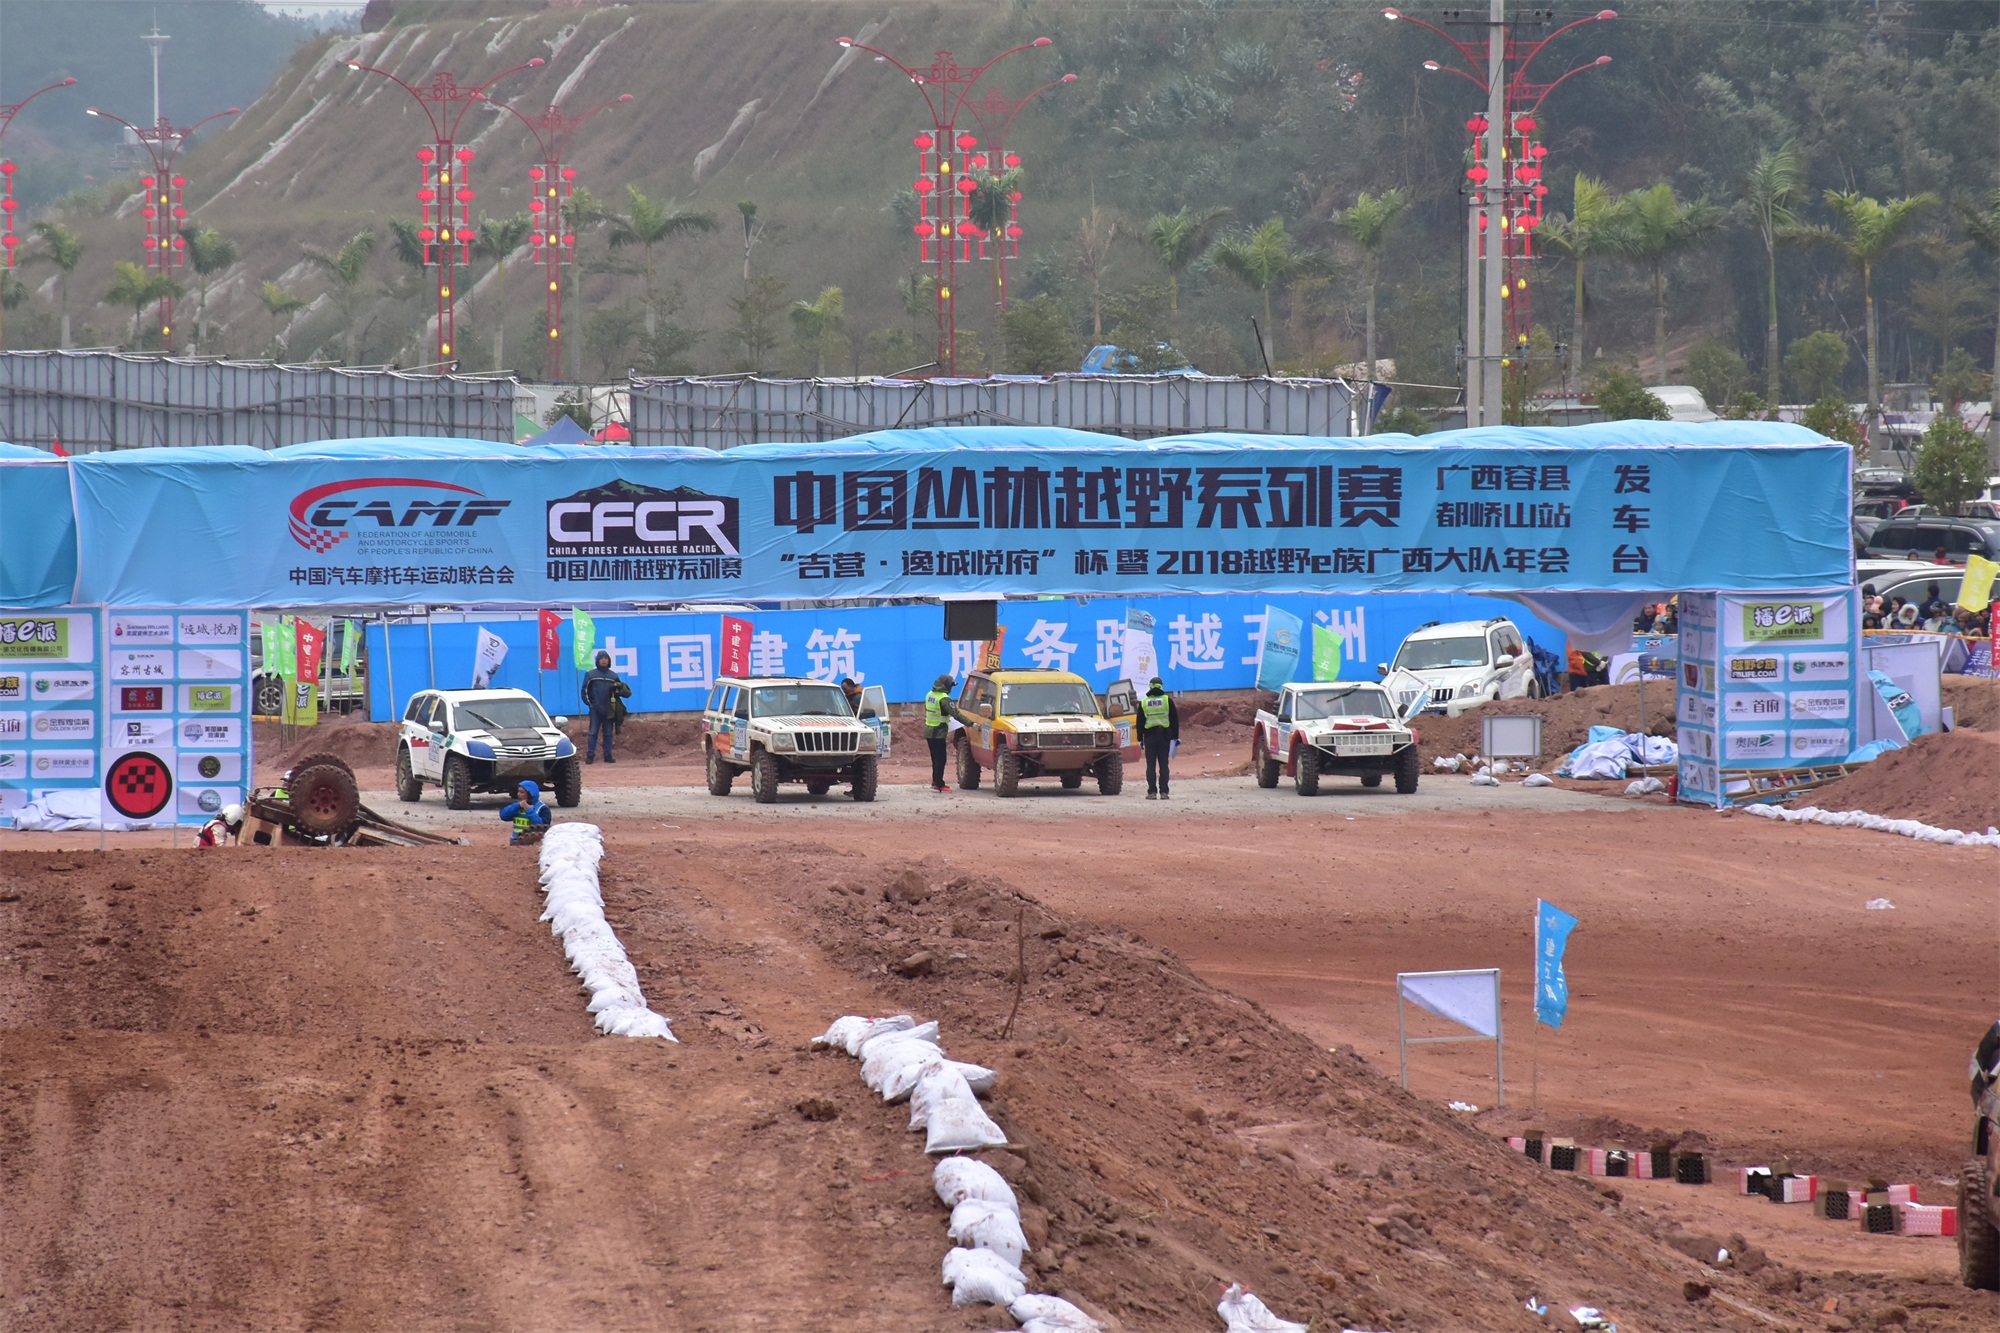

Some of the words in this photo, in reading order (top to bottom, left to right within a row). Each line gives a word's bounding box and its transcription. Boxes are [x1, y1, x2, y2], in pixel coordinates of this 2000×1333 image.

[1436, 464, 1570, 491] 广西容县
[773, 466, 1402, 533] 中国丛林越野系列赛
[311, 500, 512, 527] CAMF
[1436, 502, 1570, 529] 都峤山站
[1612, 464, 1652, 574] 发车台
[424, 530, 477, 538] AUTOMOBILE
[549, 500, 740, 555] CFCR
[377, 539, 434, 547] MOTORCYCLE
[468, 547, 493, 555] CHINA
[549, 547, 578, 555] CHINA
[582, 546, 618, 555] FOREST
[622, 546, 678, 554] CHALLENGE
[683, 545, 717, 553] RACING
[289, 565, 515, 586] 中国汽车摩托车运动联合会
[546, 557, 743, 582] 中国丛林越野系列赛
[1753, 604, 1814, 628] 播e派
[731, 622, 742, 673] 中建五局
[1731, 658, 1778, 670] 越野e族
[1753, 699, 1779, 713] 首府
